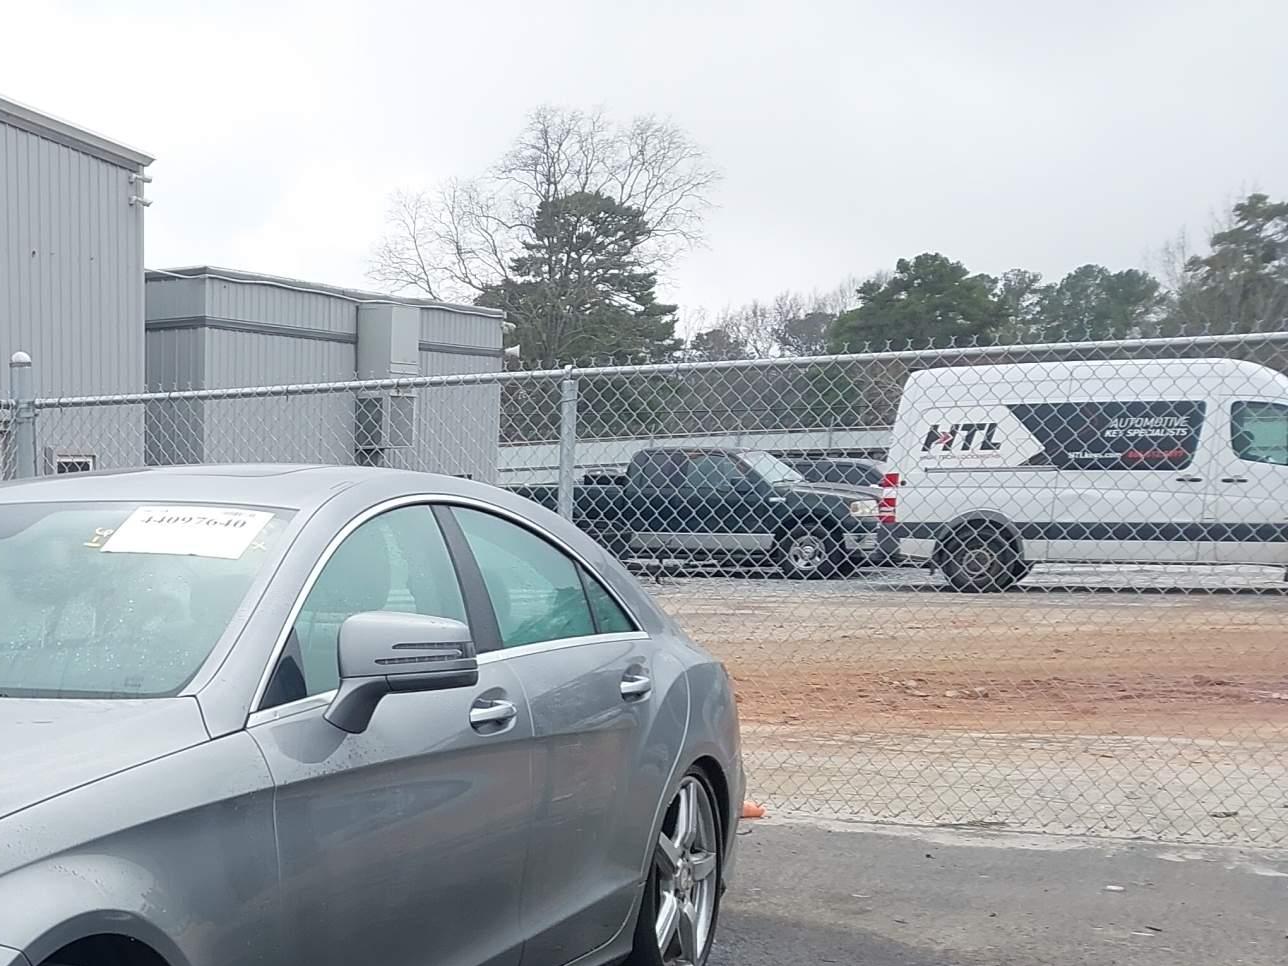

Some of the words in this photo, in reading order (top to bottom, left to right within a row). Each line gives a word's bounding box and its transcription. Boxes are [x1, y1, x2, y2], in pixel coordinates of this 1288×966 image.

[1110, 416, 1190, 428] AUTOMOTIVE
[921, 422, 1002, 451] HTL
[1125, 427, 1188, 437] SPECIALISTS
